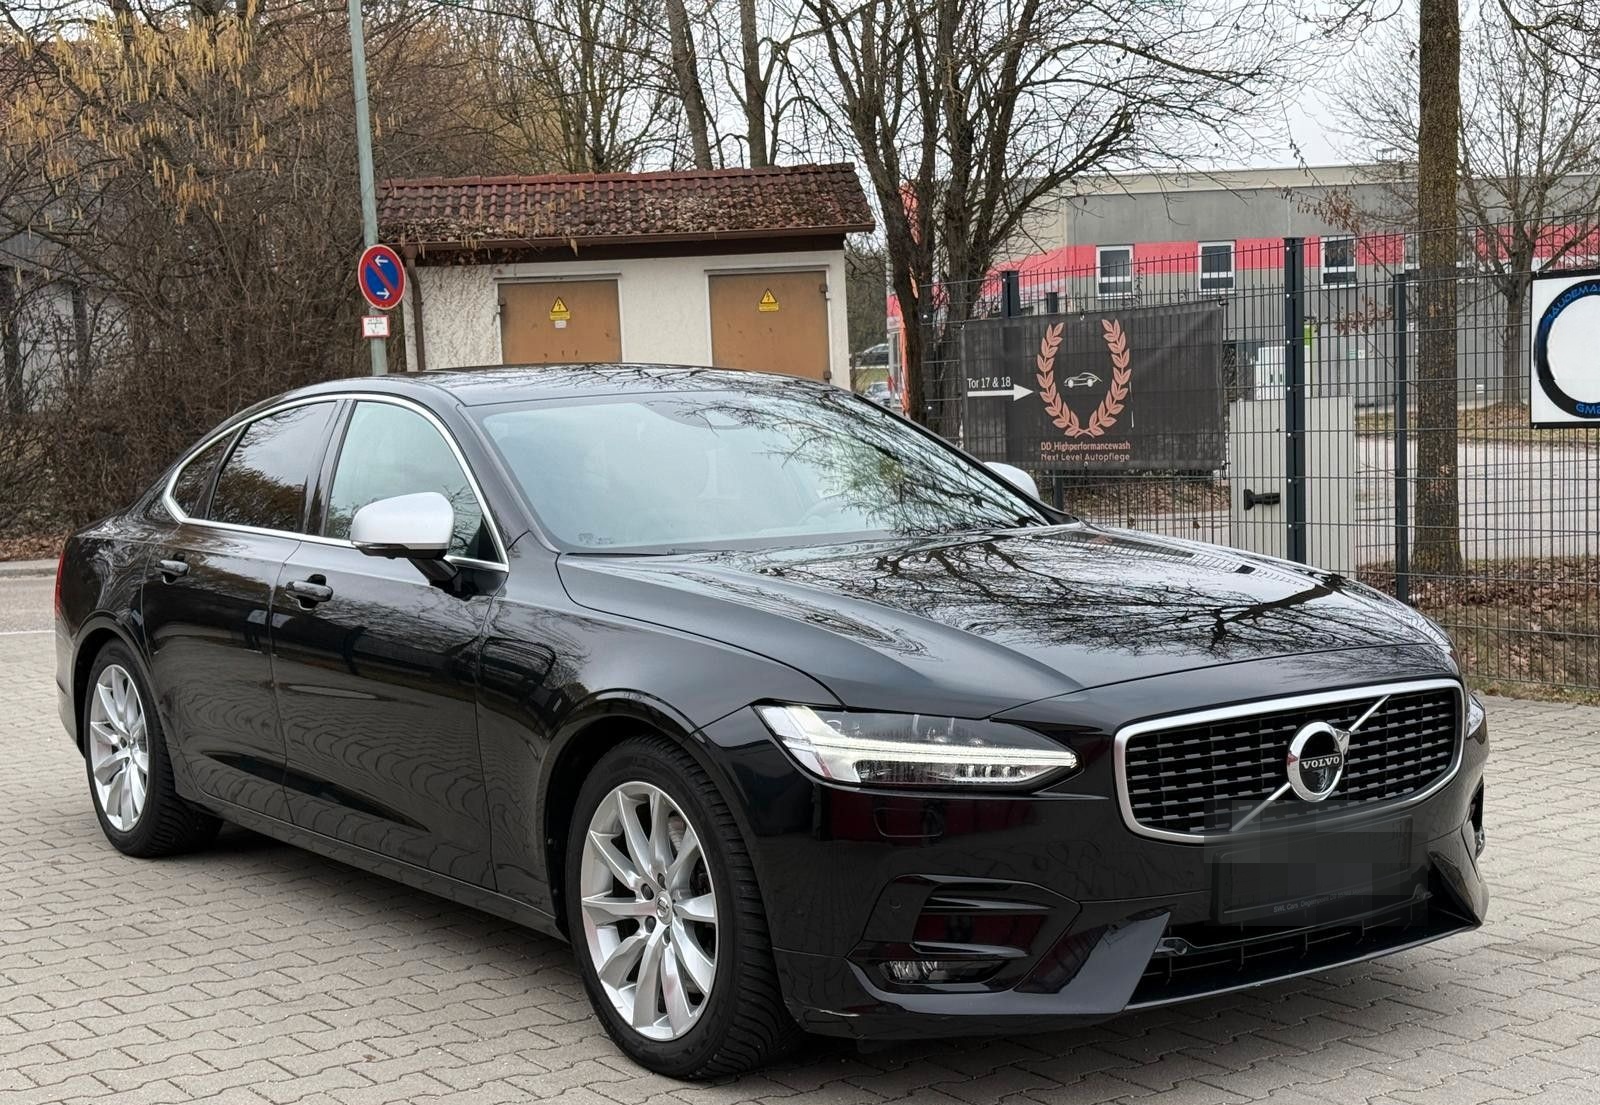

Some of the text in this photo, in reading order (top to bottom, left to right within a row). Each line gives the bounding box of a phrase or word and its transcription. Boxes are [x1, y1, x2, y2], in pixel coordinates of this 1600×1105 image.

[967, 376, 1011, 388] Tor 17 & 18
[1041, 453, 1130, 463] Next Level Autopflege
[1301, 756, 1340, 769] VOLVO
